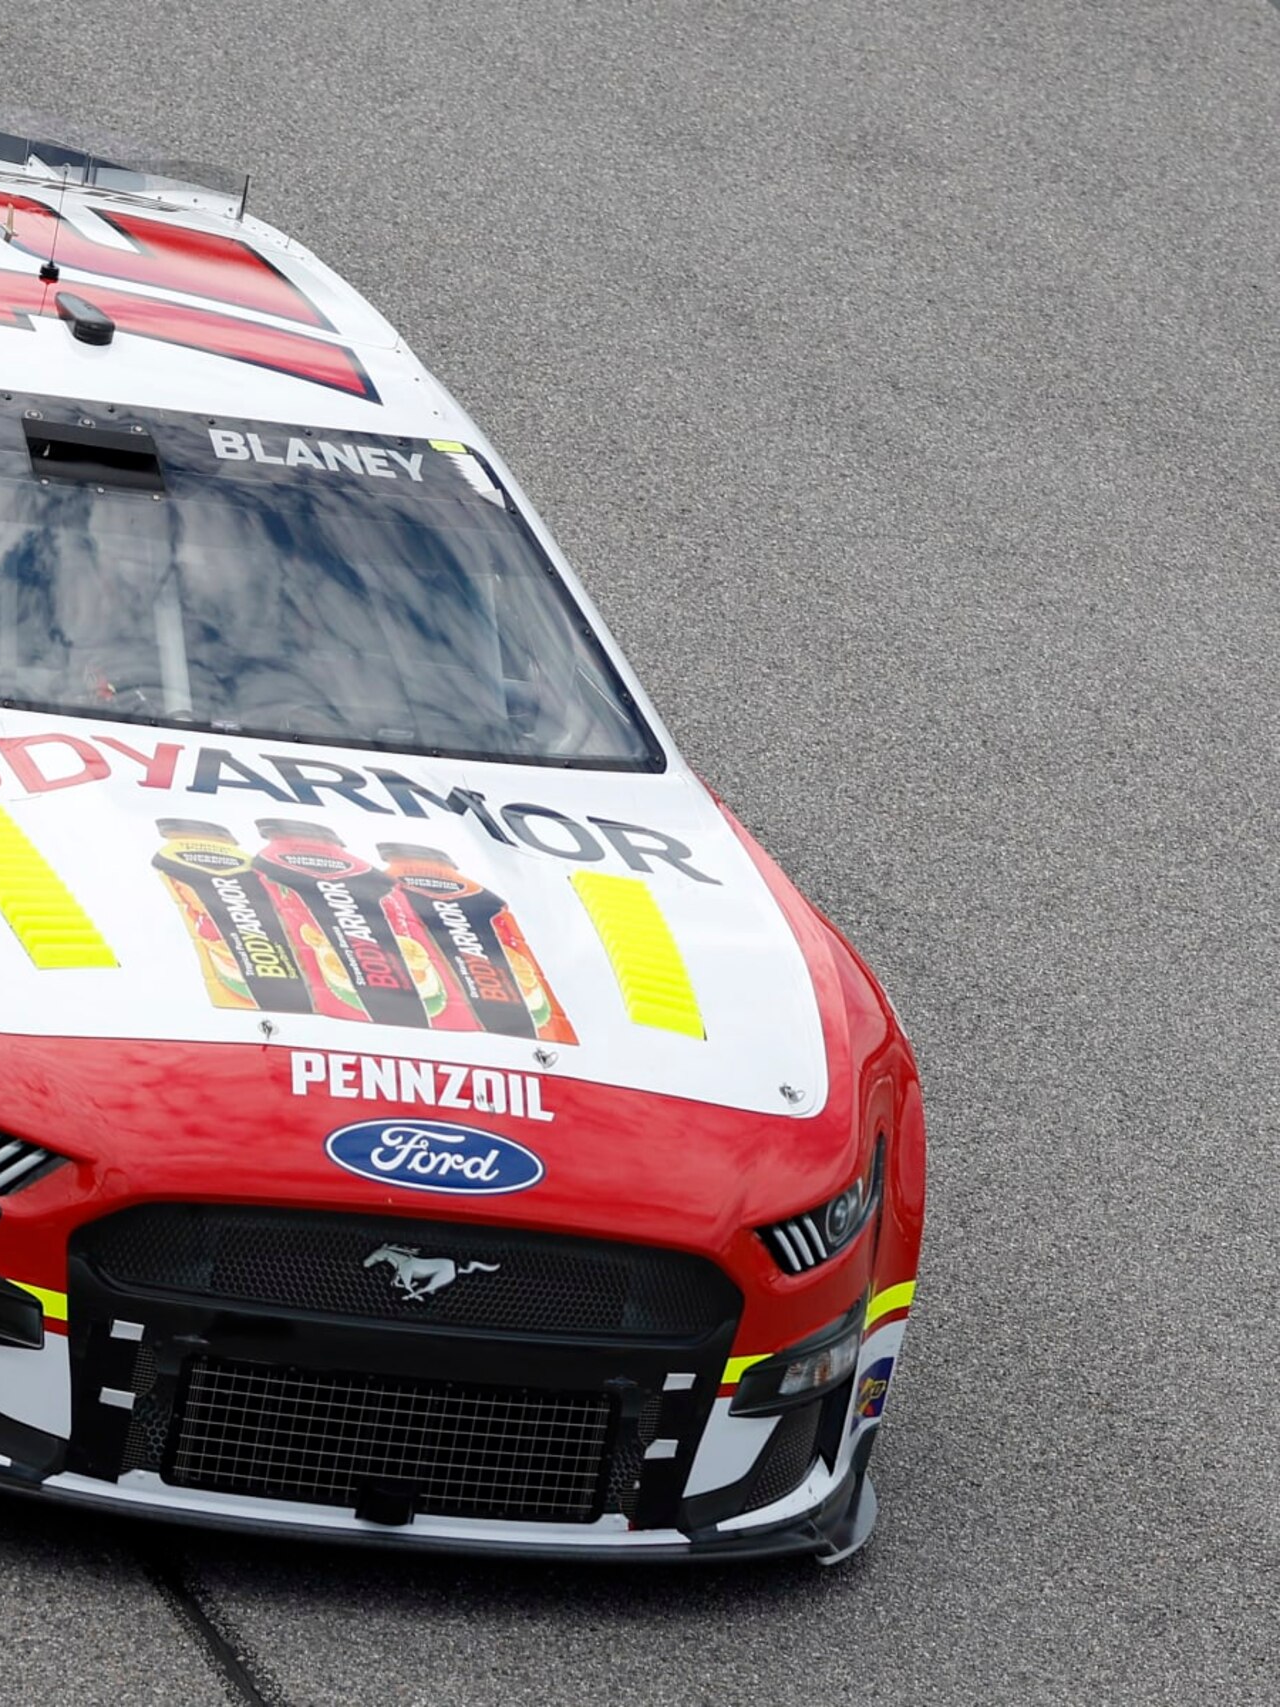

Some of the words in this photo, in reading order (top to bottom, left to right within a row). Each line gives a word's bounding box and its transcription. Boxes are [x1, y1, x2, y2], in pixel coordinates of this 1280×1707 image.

[210, 428, 427, 483] BLANEY
[213, 877, 285, 979] BODYARMOR
[318, 881, 399, 990] BODYARMOR
[433, 900, 510, 1003] BODYARMOR
[290, 1051, 555, 1122] PENNZOIL
[370, 1126, 500, 1182] Ford
